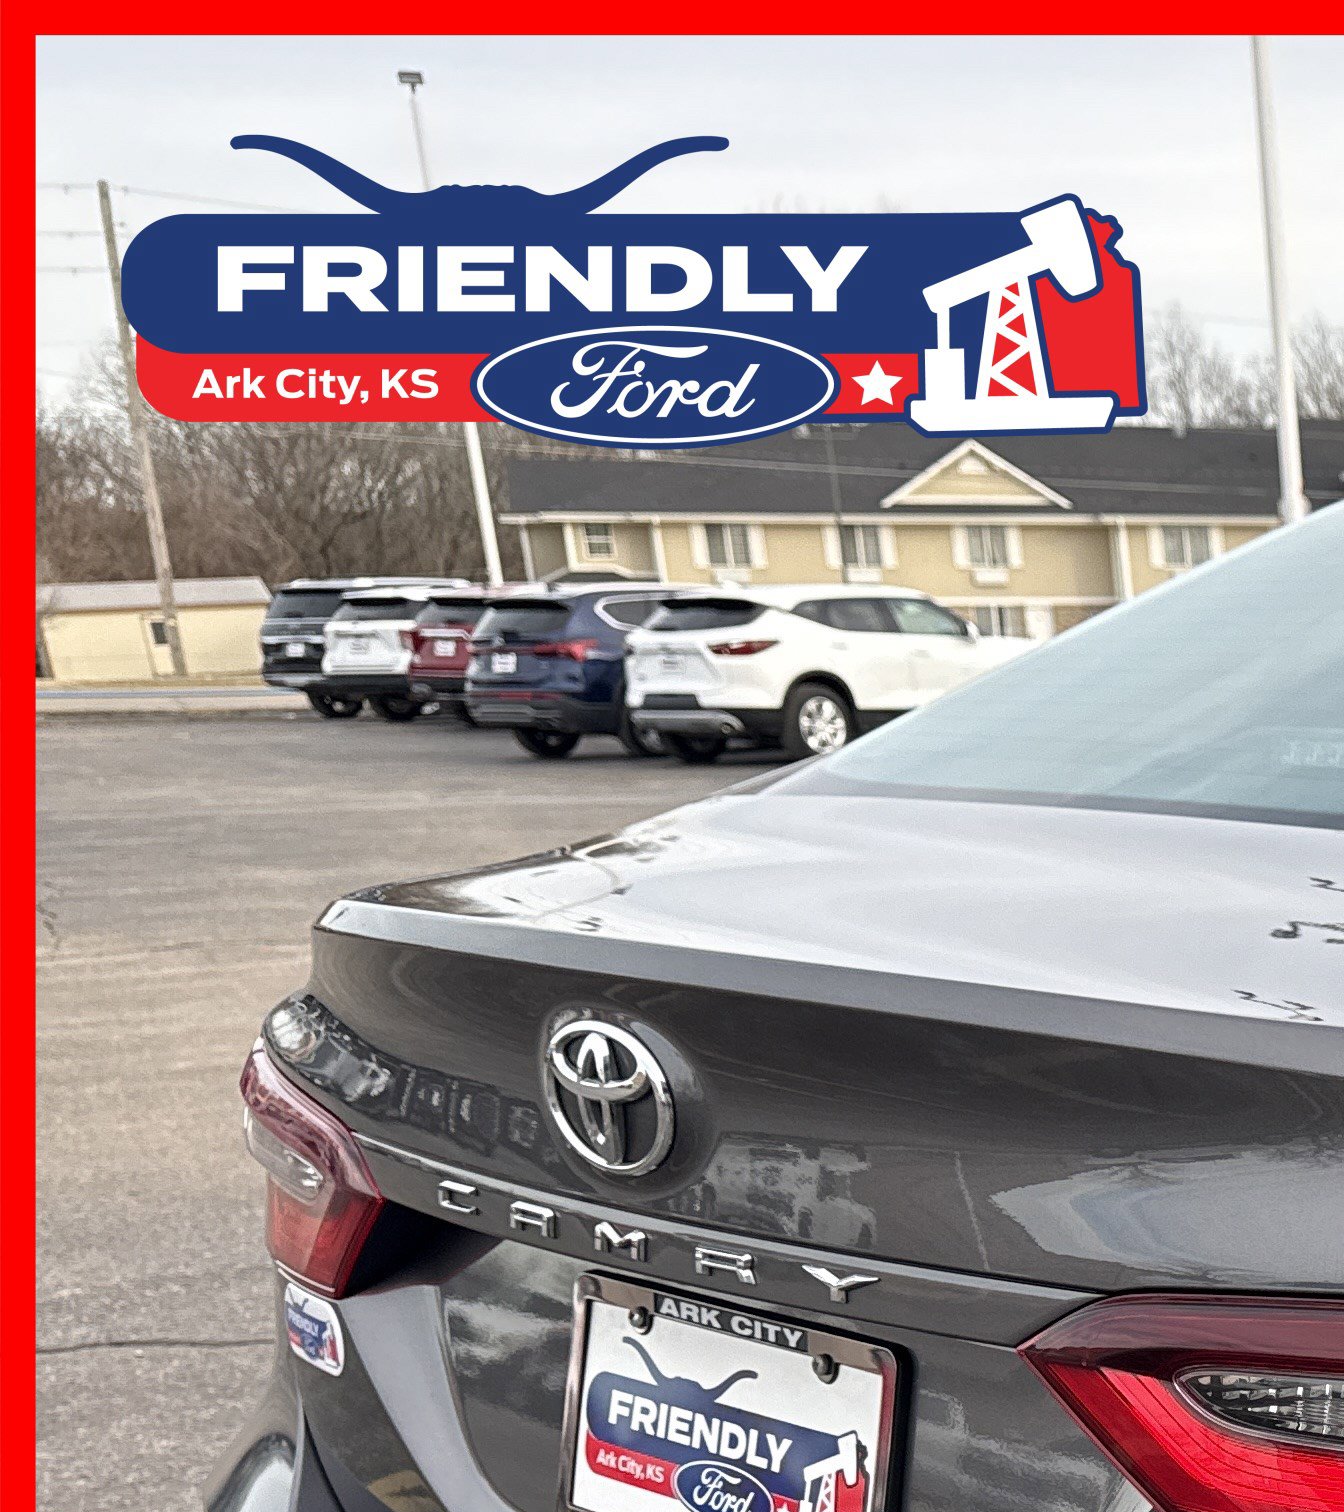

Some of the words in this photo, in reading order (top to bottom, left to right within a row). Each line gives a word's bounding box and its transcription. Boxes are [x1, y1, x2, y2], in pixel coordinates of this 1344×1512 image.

[437, 1180, 882, 1303] CAMRY
[659, 1297, 721, 1329] ARK
[729, 1315, 804, 1349] CITY
[595, 1447, 617, 1467] Ark
[617, 1456, 646, 1480] City,
[645, 1464, 665, 1483] KS
[607, 1389, 794, 1473] FRIENDLY
